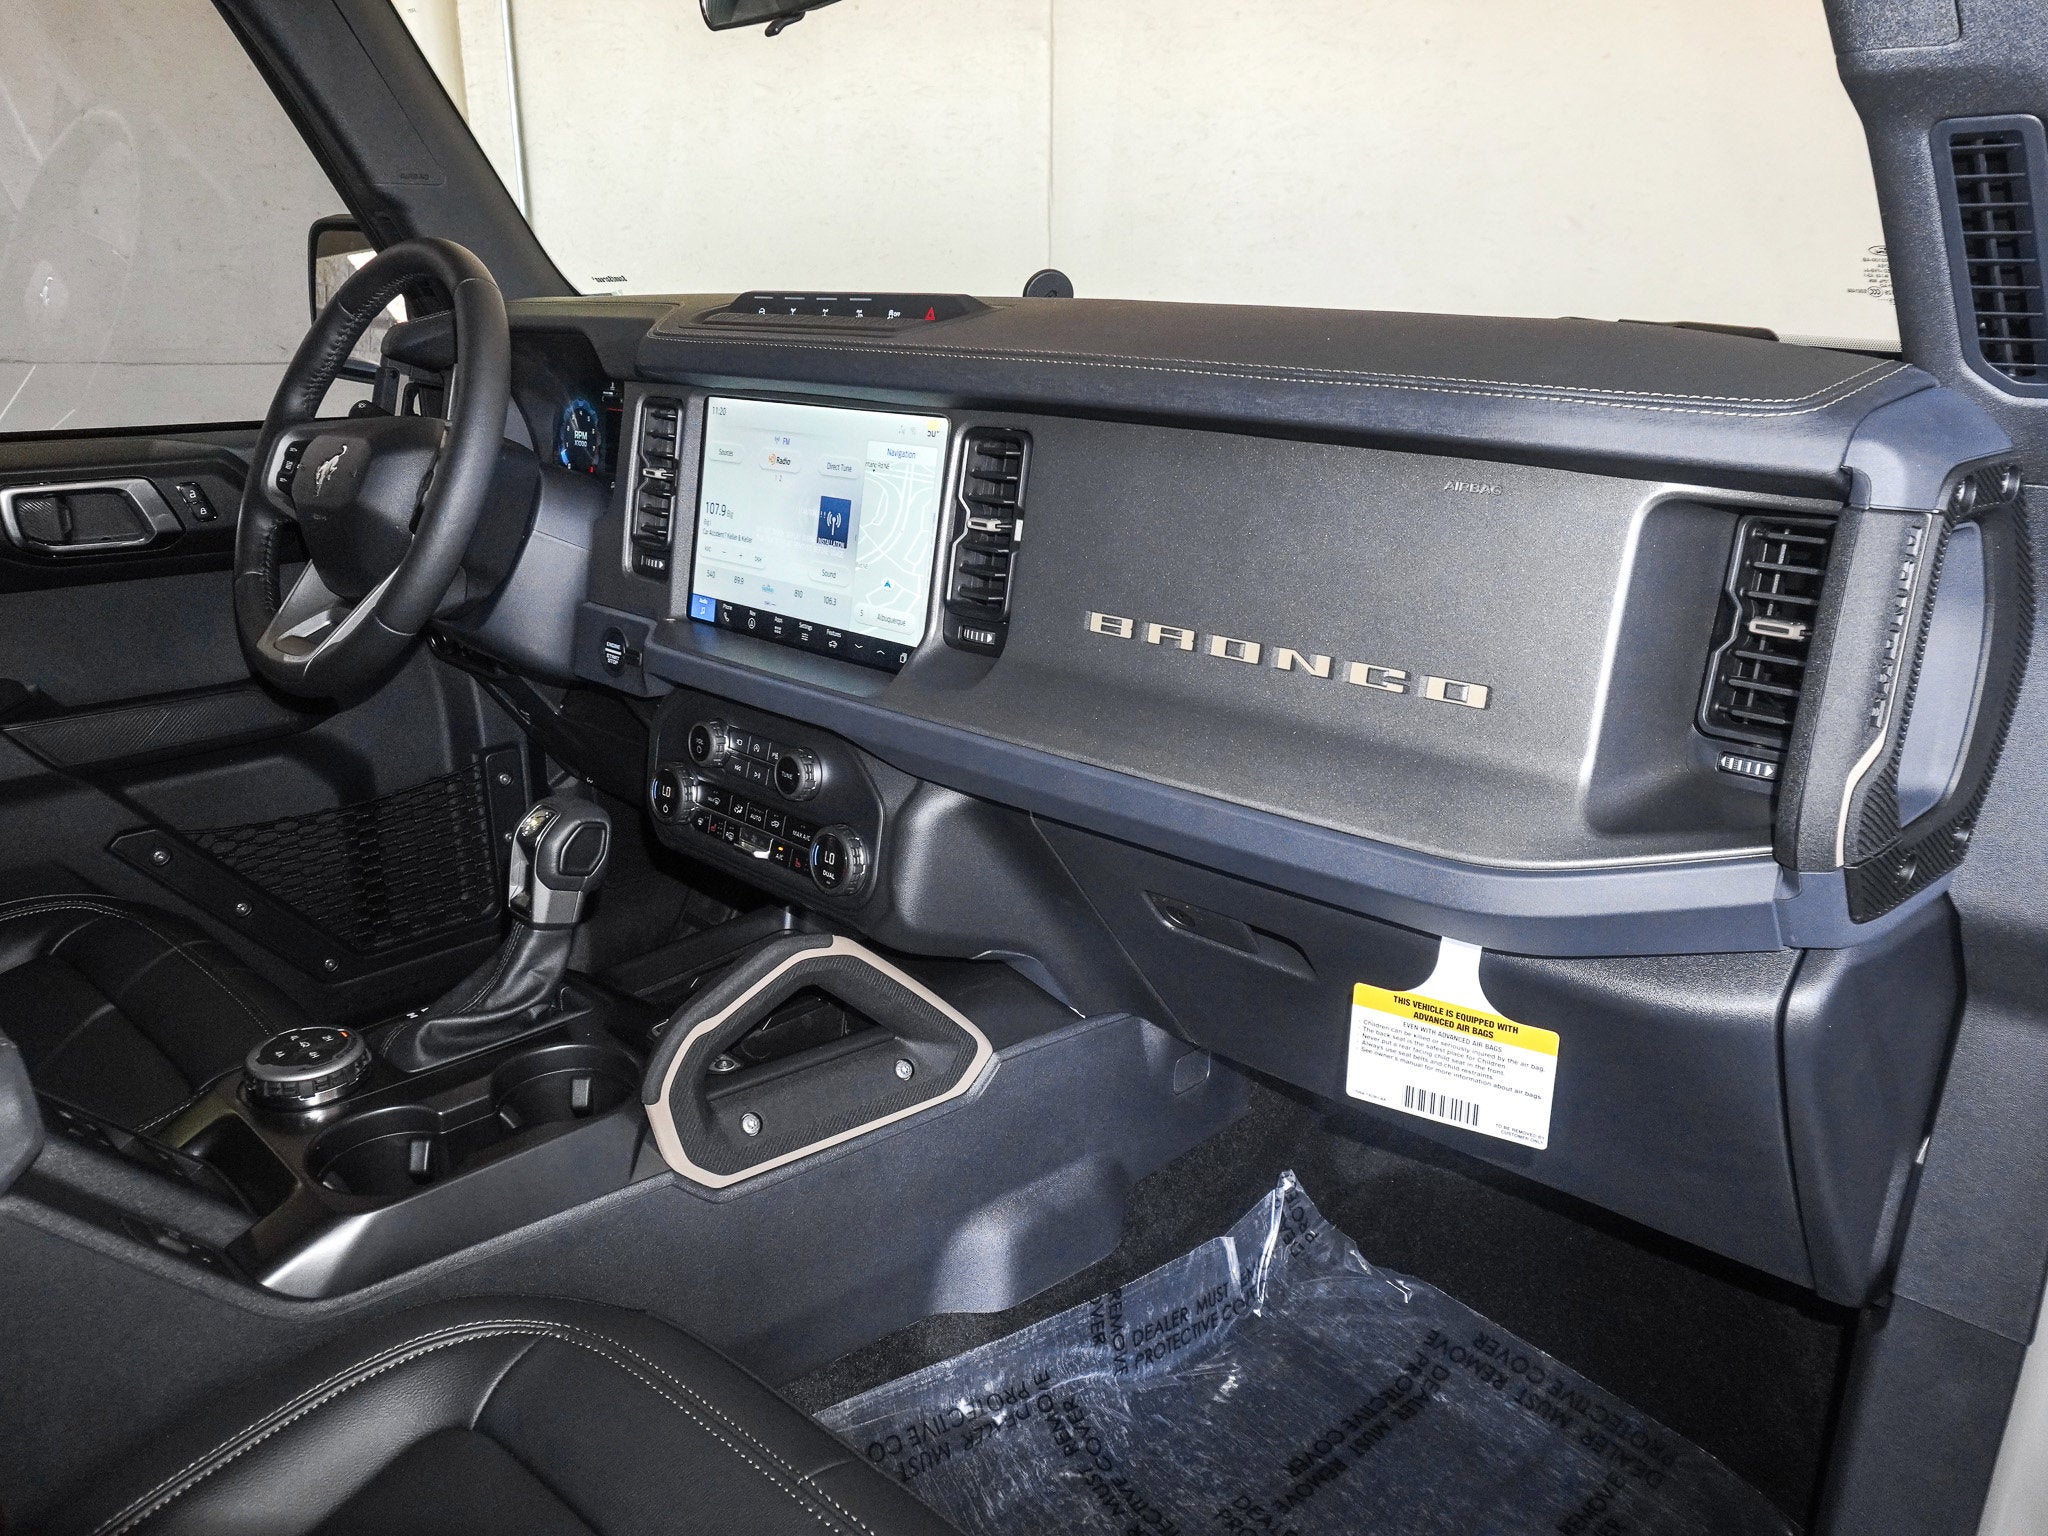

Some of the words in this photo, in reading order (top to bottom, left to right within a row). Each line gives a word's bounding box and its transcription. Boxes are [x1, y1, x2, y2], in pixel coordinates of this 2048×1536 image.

[574, 430, 588, 440] RPM
[782, 437, 791, 446] FM
[776, 456, 791, 466] Radio
[826, 462, 840, 471] Direct
[840, 463, 852, 473] Tune
[886, 448, 916, 459] Navigation
[1443, 480, 1503, 496] AIRBAG
[706, 501, 727, 517] 107.9
[822, 569, 837, 579] Sound
[823, 595, 837, 606] 106.3
[877, 613, 906, 627] Albuquerque
[1087, 611, 1491, 710] BRONCO
[781, 770, 793, 780] TUNE
[750, 814, 762, 822] AUTO
[792, 830, 801, 838] MAX
[775, 853, 784, 861] A/C
[824, 850, 835, 865] LO
[822, 869, 835, 880] DUAL
[1393, 995, 1411, 1006] THIS
[1412, 1000, 1444, 1015] VEHICLE
[1446, 1009, 1454, 1018] IS
[1455, 1012, 1495, 1029] EQUIPPED
[1497, 1022, 1519, 1034] WITH
[1413, 1011, 1455, 1029] ADVANCED
[1456, 1022, 1470, 1033] AIR
[1472, 1027, 1494, 1039] BAGS
[1363, 1019, 1390, 1031] Children
[1472, 1049, 1496, 1060] injured
[1497, 1055, 1505, 1063] by
[1507, 1058, 1519, 1066] the
[1375, 1029, 1390, 1038] back
[1392, 1034, 1406, 1042] seat
[1414, 1040, 1425, 1048] the
[1426, 1043, 1446, 1053] safest
[1446, 1050, 1465, 1059] place
[1477, 1057, 1506, 1069] Children
[1402, 1021, 1419, 1031] EVEN
[1420, 1026, 1436, 1035] WITH
[1437, 1031, 1471, 1045] ADVANCED
[1472, 1039, 1483, 1047] AIR
[1484, 1044, 1503, 1053] BAGS
[1361, 1040, 1384, 1051] Always
[1398, 1050, 1412, 1058] seat
[1413, 1054, 1428, 1063] belts
[1443, 1062, 1460, 1072] child
[1362, 1033, 1380, 1042] Never
[1381, 1038, 1392, 1046] put
[1434, 1052, 1450, 1061] child
[1451, 1057, 1465, 1066] seat
[1474, 1063, 1486, 1071] the
[1399, 1057, 1424, 1068] manual
[1424, 1063, 1434, 1071] for
[1435, 1068, 1452, 1078] more
[1453, 1070, 1492, 1087] information
[1493, 1083, 1513, 1093] about
[1132, 1307, 1189, 1348] DEALER
[1196, 1282, 1230, 1315] MUST
[1134, 1312, 1218, 1370] PROTECTIVE
[1424, 1328, 1511, 1391] REMOVE
[1473, 1331, 1546, 1385] COVER
[1063, 1398, 1112, 1471] COVER
[1349, 1420, 1393, 1458] MUST
[900, 1442, 951, 1483] MUST
[1283, 1430, 1345, 1478] COVER
